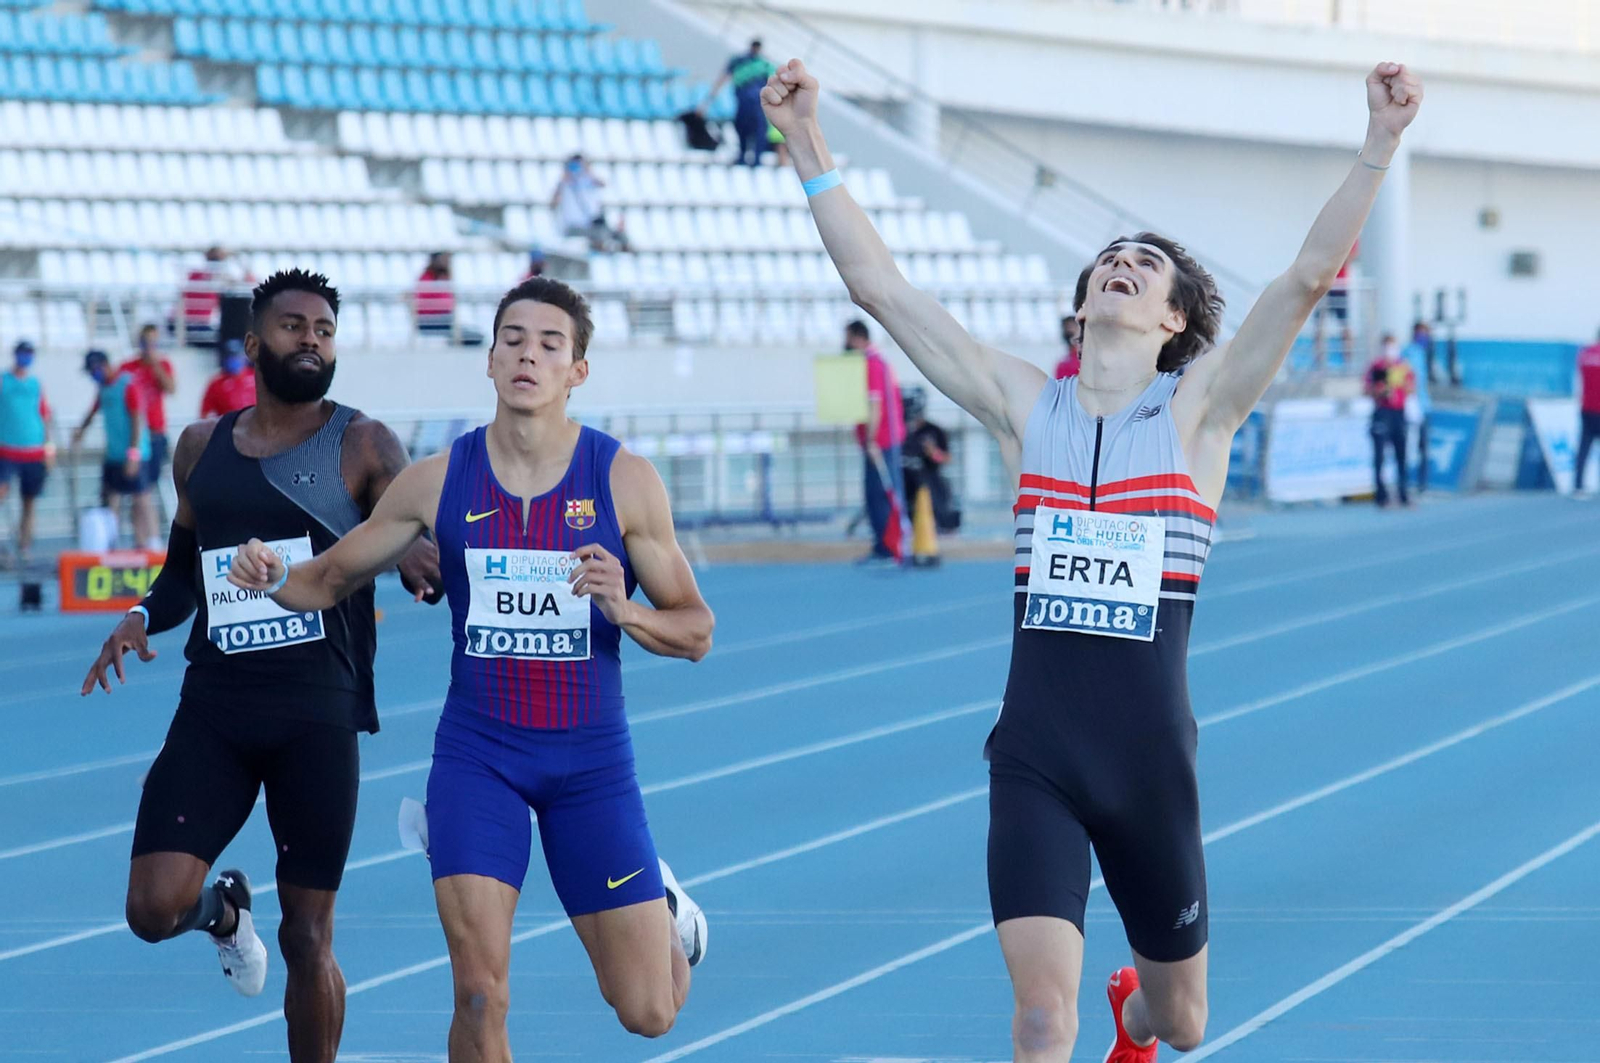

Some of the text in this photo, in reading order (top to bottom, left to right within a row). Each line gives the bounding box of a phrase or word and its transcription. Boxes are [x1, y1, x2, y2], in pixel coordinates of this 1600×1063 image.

[1076, 528, 1146, 543] DE HUELVA
[511, 566, 524, 575] DE
[1049, 554, 1134, 587] ERTA
[497, 591, 561, 616] BUA
